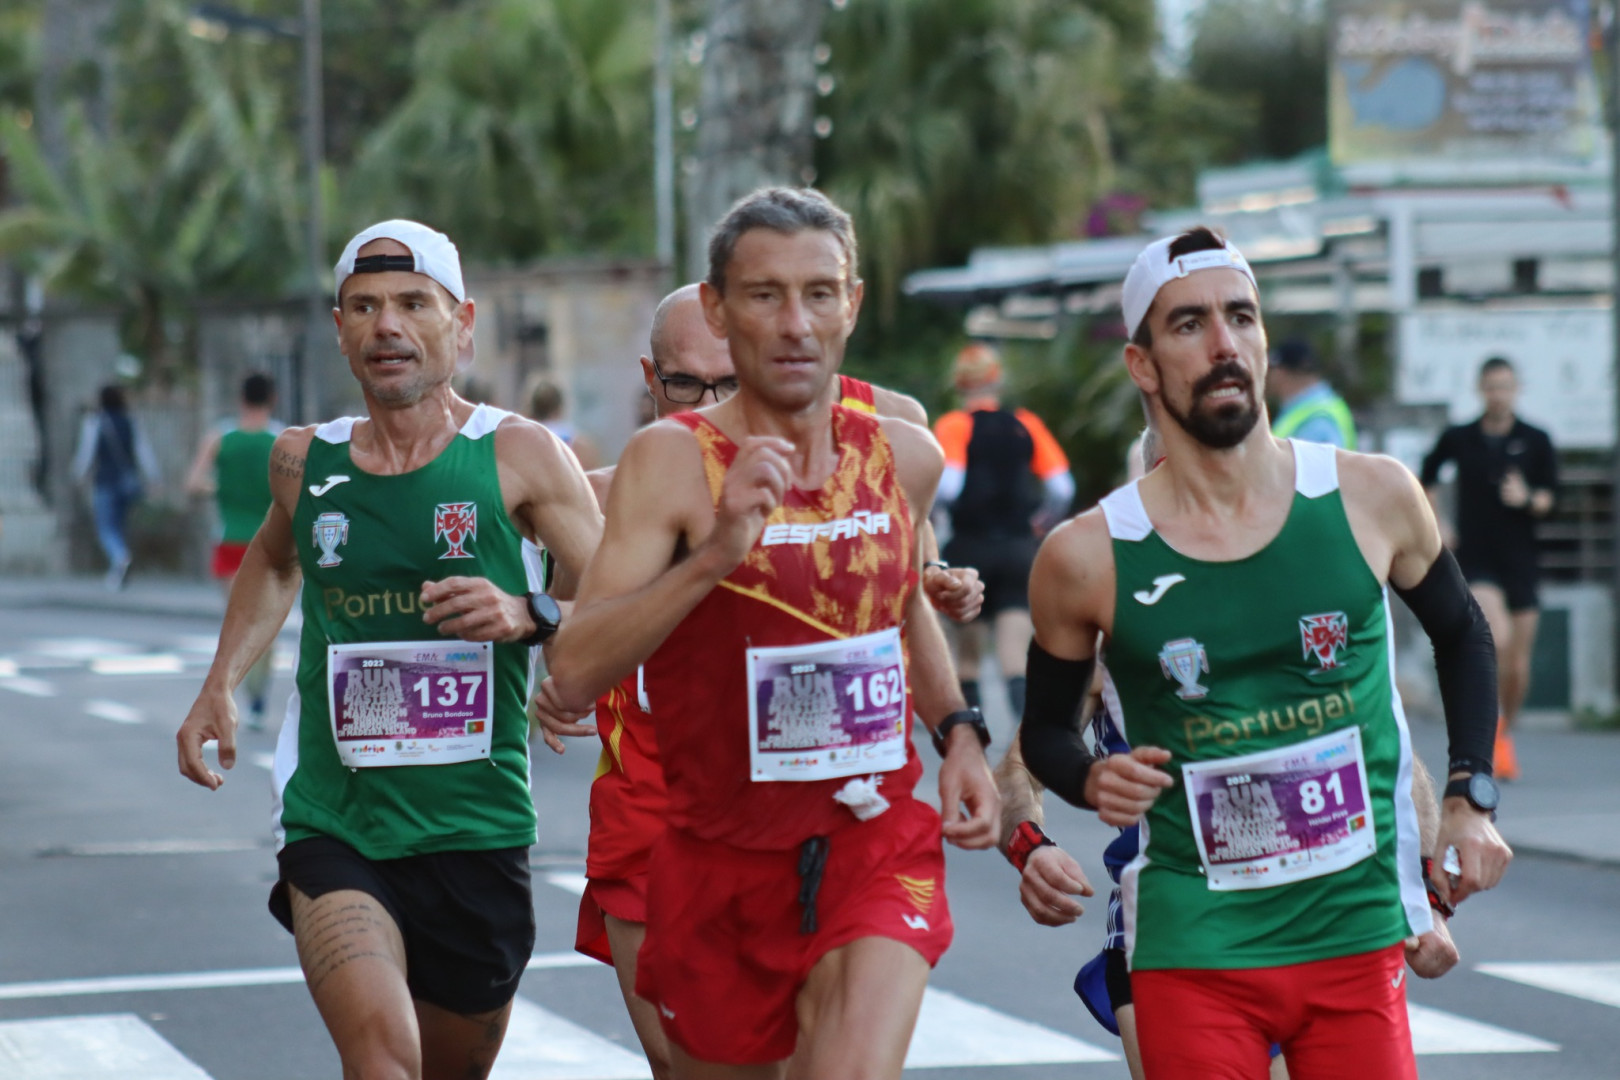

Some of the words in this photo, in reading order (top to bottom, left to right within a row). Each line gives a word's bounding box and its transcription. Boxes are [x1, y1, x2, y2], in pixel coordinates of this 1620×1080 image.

[761, 510, 890, 546] ESPAÑA
[362, 659, 384, 667] 2023
[348, 667, 401, 690] RUN
[413, 675, 483, 707] 137
[772, 671, 835, 700] RUN
[846, 668, 902, 711] 162
[1184, 684, 1355, 752] Portugal
[1211, 780, 1276, 809] RUN
[1226, 773, 1251, 786] 2023
[1299, 771, 1345, 814] 81
